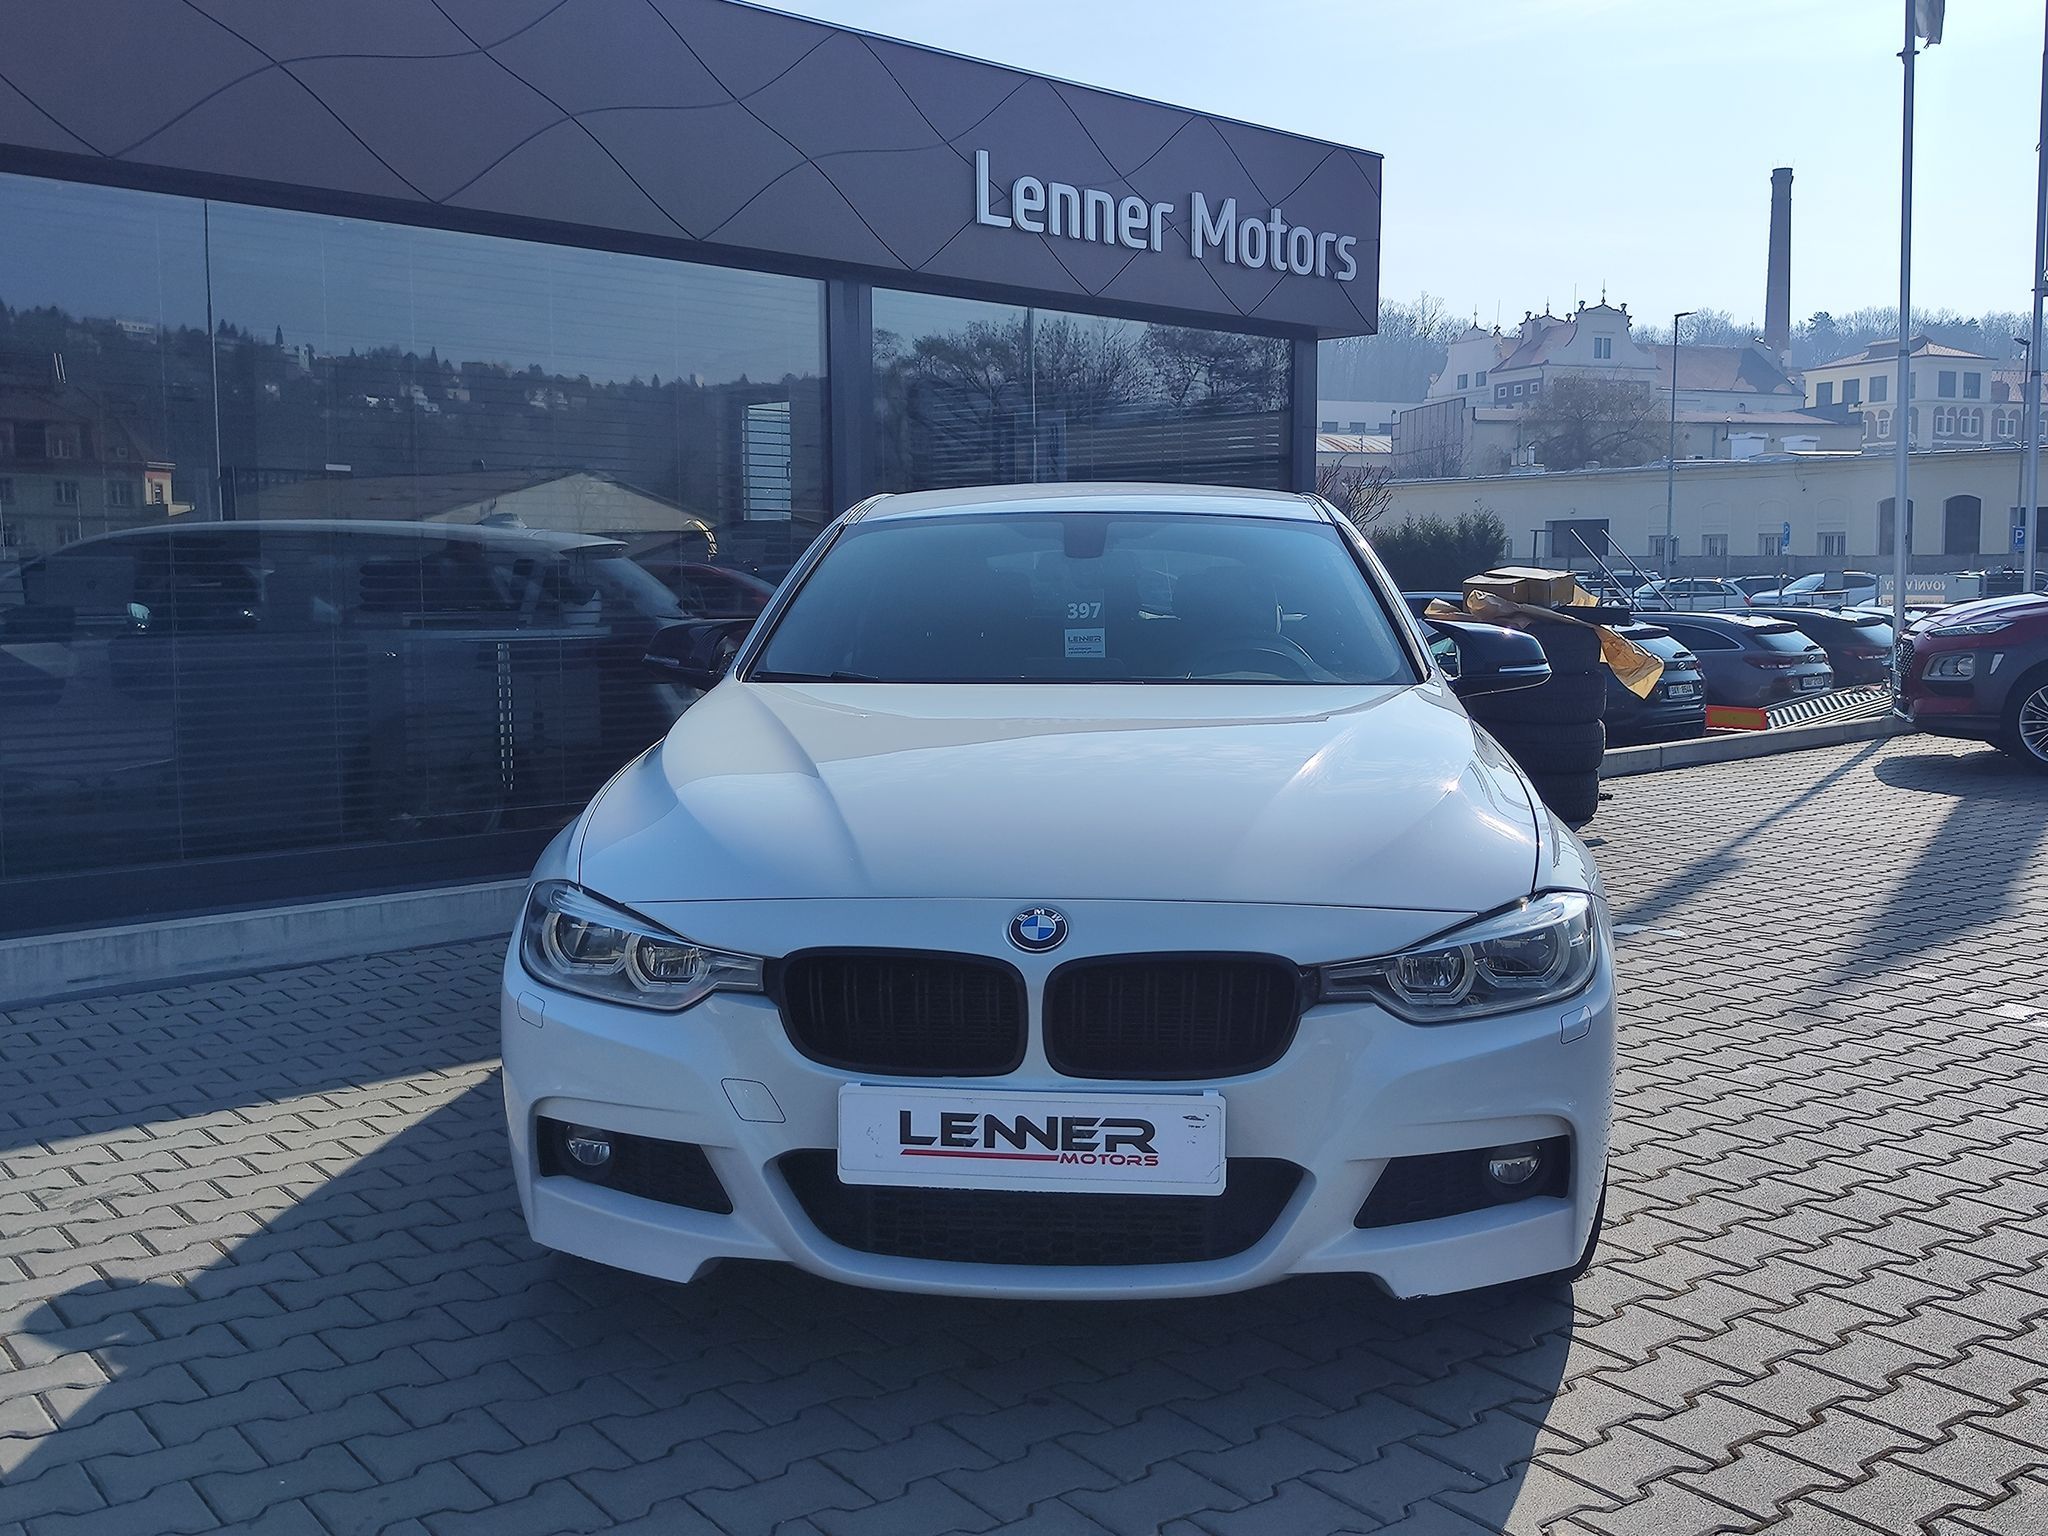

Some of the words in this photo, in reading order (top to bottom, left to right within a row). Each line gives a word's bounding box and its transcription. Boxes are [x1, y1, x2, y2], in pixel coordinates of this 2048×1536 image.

[975, 149, 1175, 253] Lenner
[1190, 191, 1358, 282] Motors
[2015, 529, 2024, 544] P
[1067, 602, 1101, 619] 397
[1017, 908, 1064, 921] BMW
[899, 1110, 1159, 1154] LENNER
[1059, 1152, 1159, 1167] MOTORS
